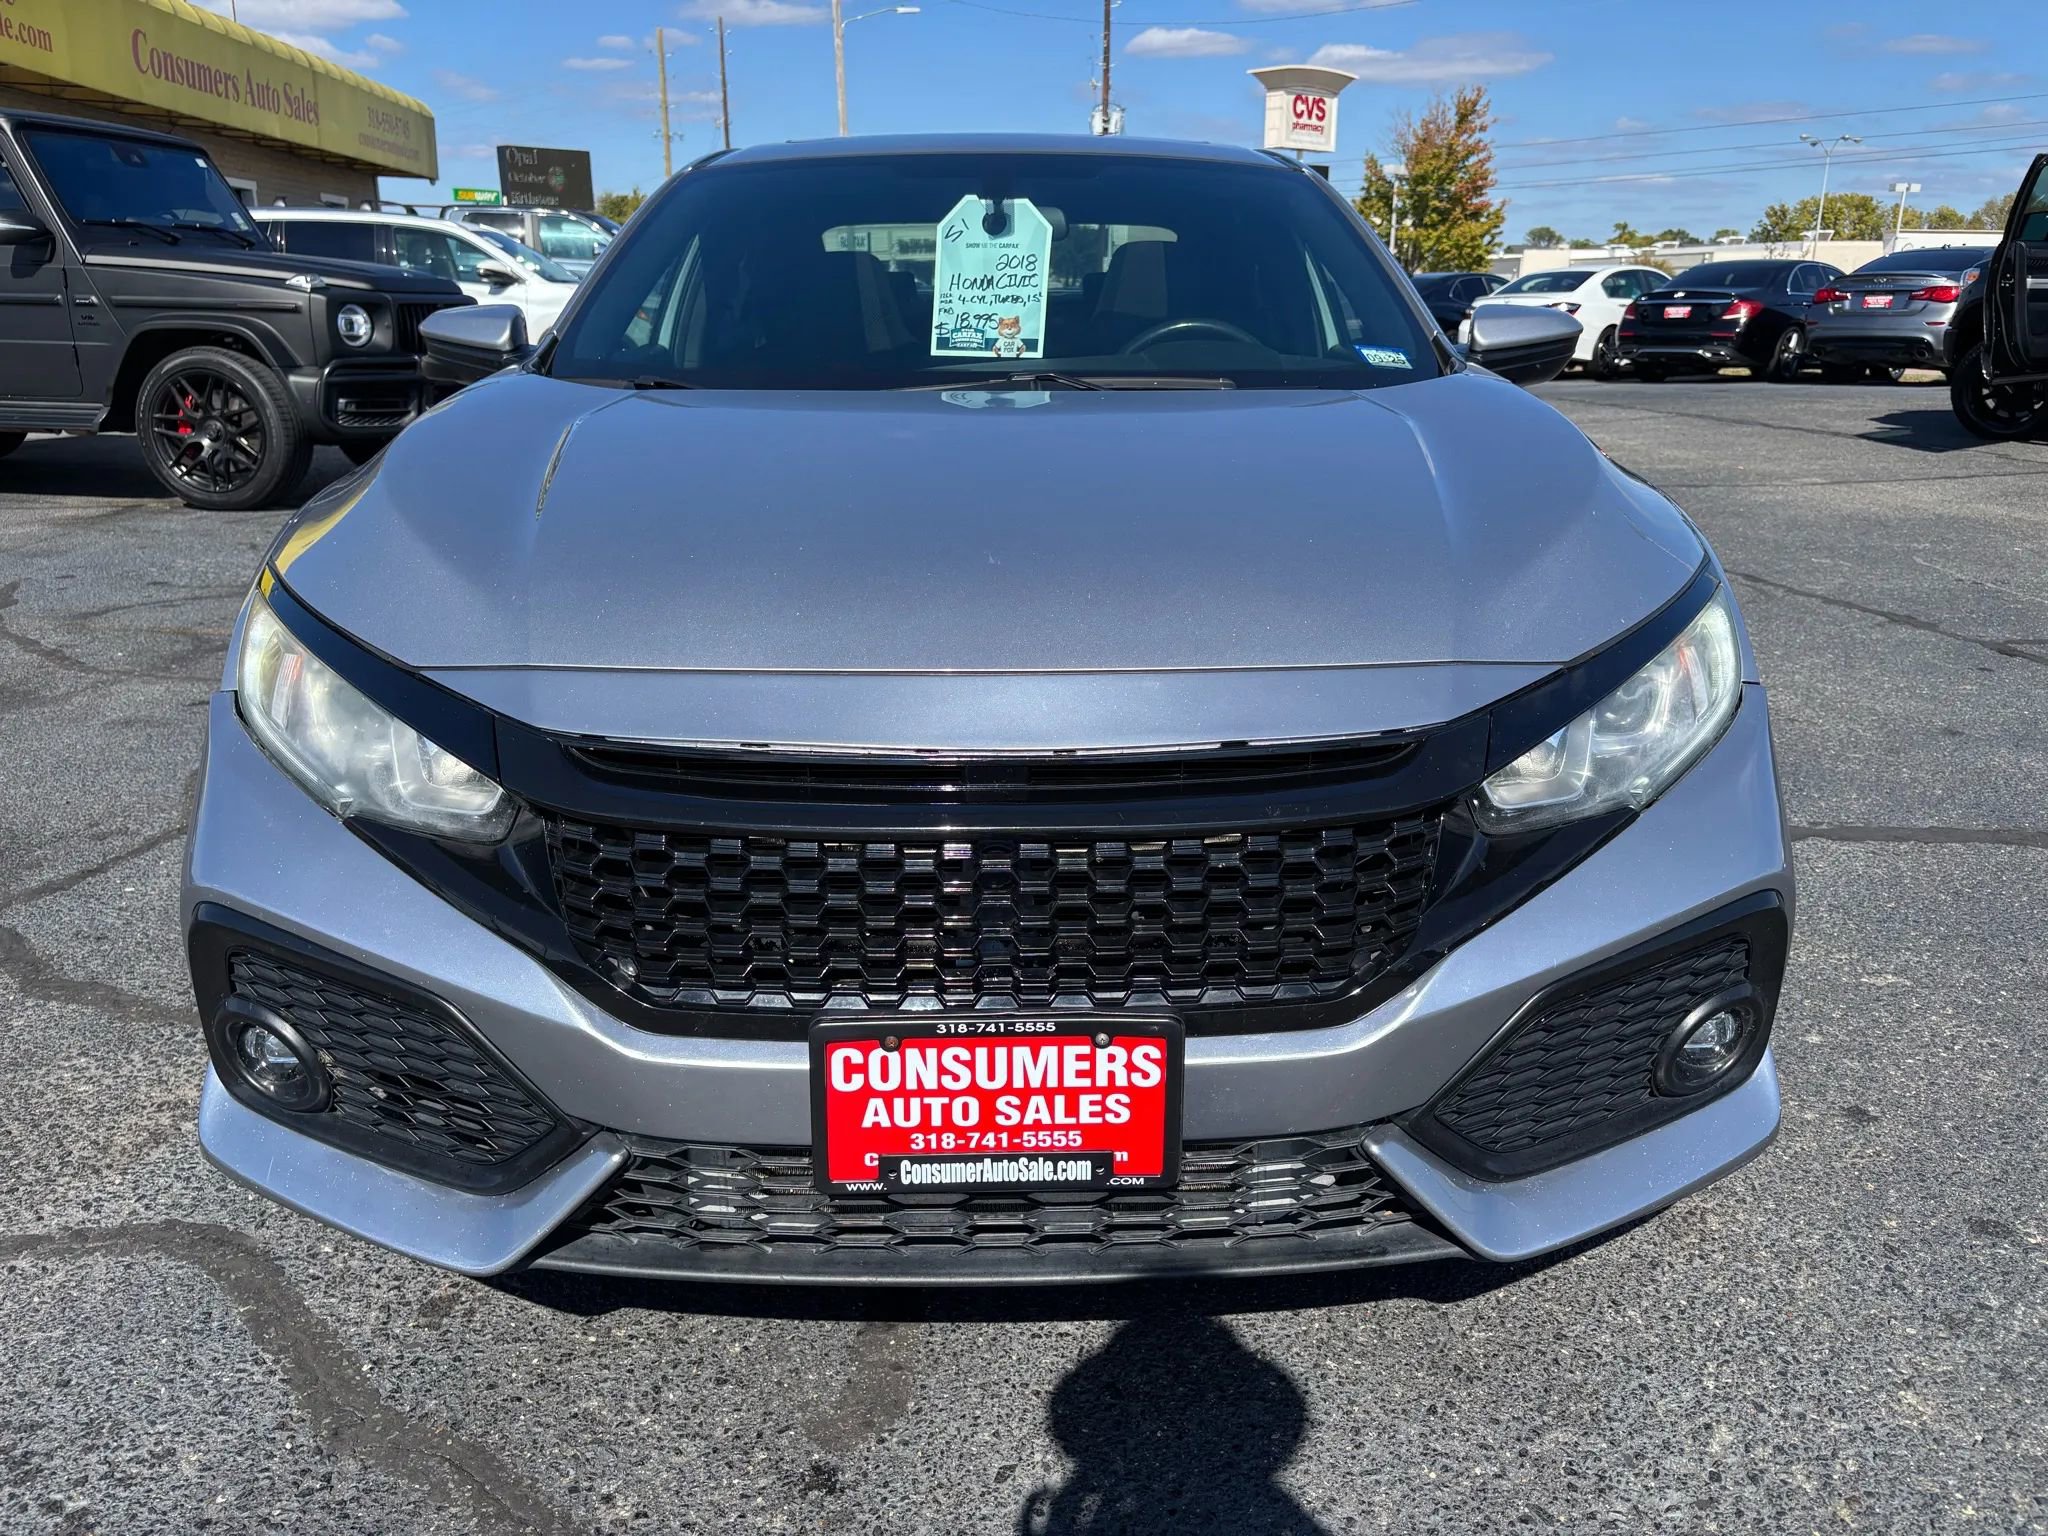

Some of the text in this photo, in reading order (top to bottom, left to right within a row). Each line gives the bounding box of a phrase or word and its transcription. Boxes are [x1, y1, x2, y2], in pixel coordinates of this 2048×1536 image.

[131, 28, 320, 127] Consumers Auto Sales
[1292, 94, 1327, 122] CVS
[1291, 121, 1325, 135] pharmacy
[505, 147, 539, 166] Opal
[456, 190, 498, 202] SUBWAY
[995, 253, 1038, 272] 2018
[949, 273, 1040, 292] HONDA CIVIC
[954, 311, 1000, 330] 18,995
[936, 1022, 1057, 1035] 318-741-5555
[830, 1044, 1163, 1093] CONSUMERS
[861, 1093, 1132, 1129] AUTO SALES
[910, 1130, 1083, 1150] 318-741-5555
[900, 1157, 1092, 1185] ConsumerAutoSale.com
[1106, 1177, 1145, 1186] .COM
